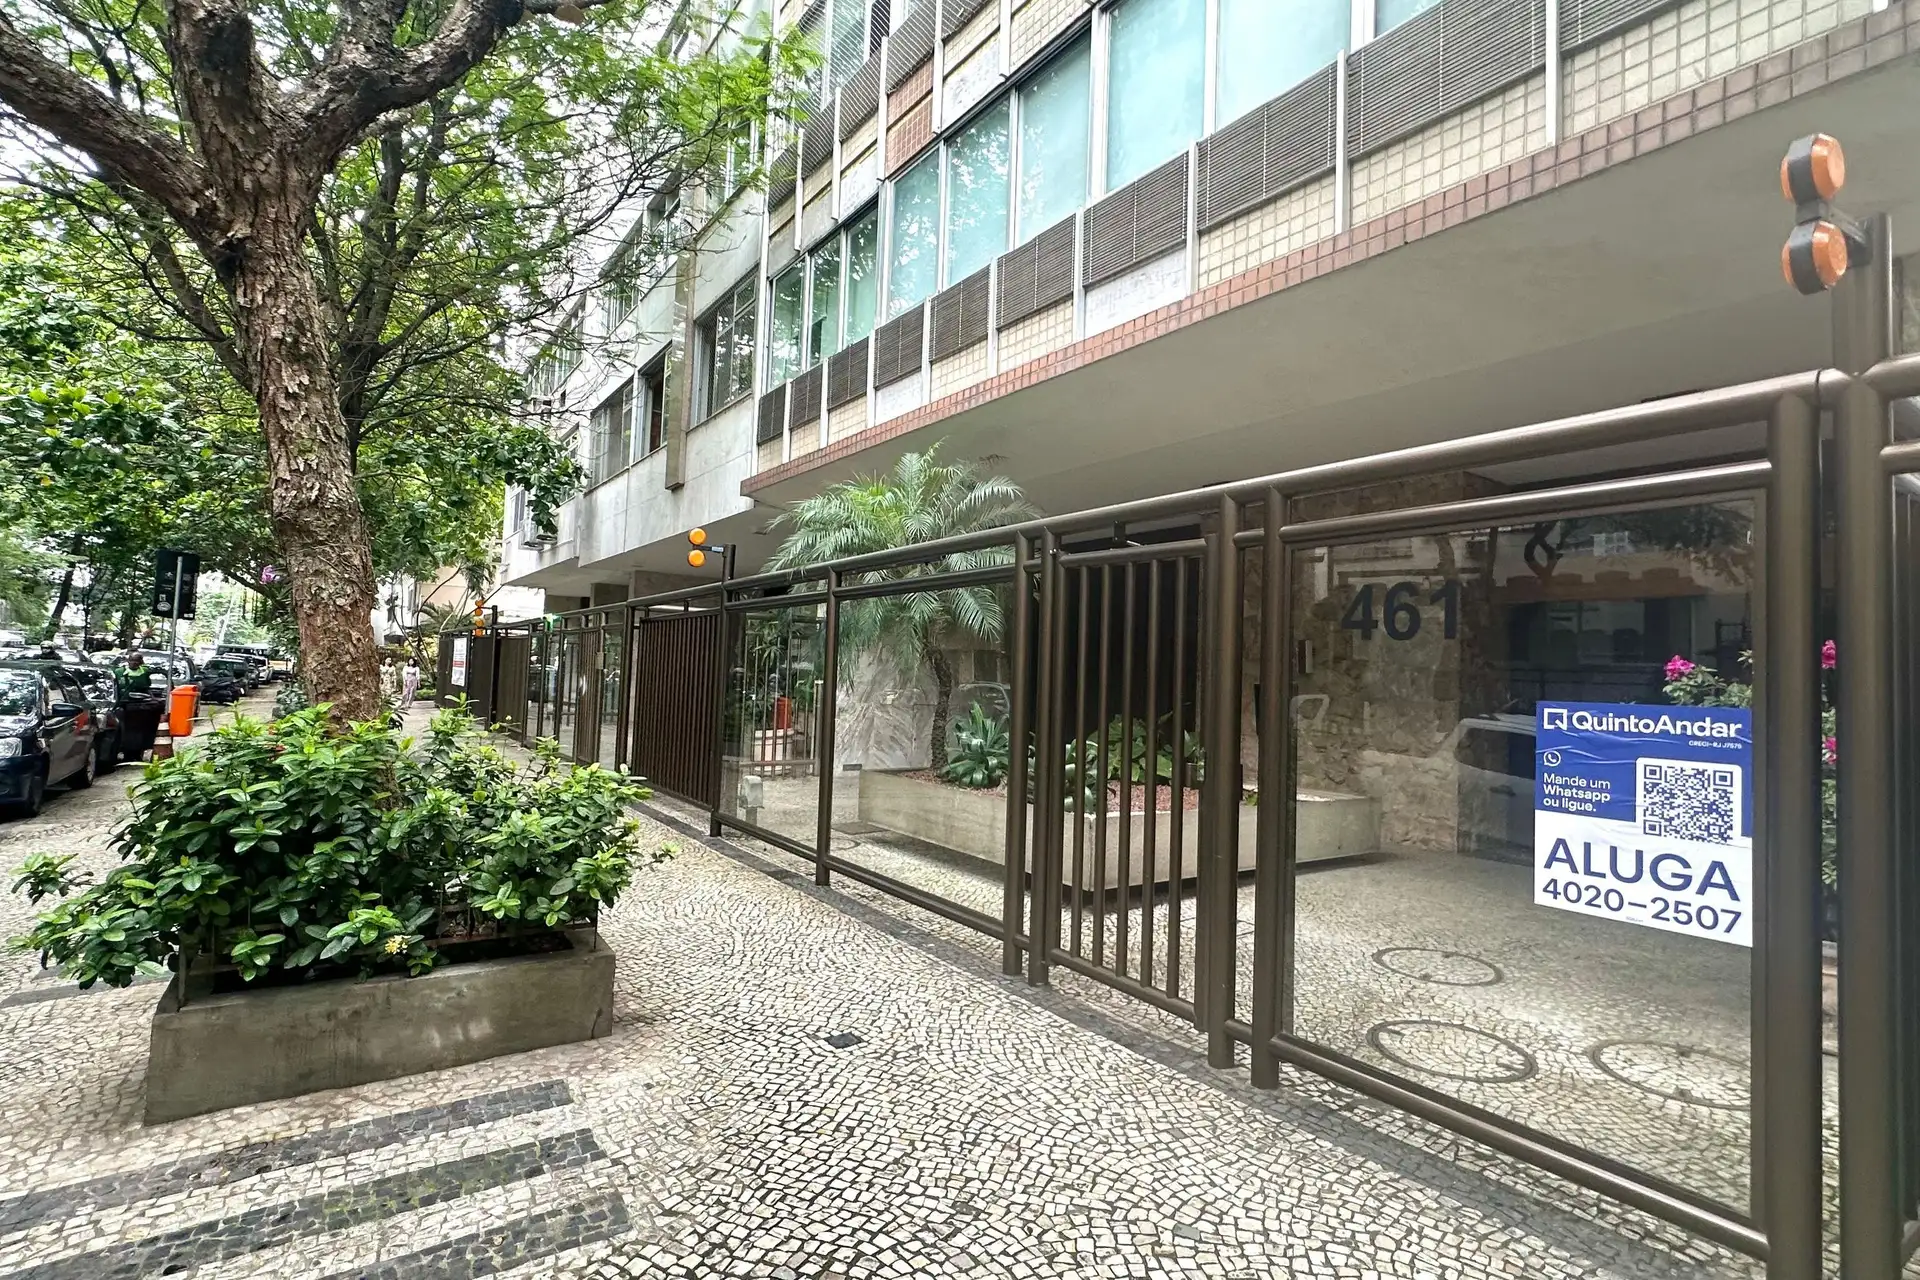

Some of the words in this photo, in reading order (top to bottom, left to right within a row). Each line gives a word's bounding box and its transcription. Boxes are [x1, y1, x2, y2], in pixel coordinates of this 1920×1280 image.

[1342, 580, 1458, 641] 461
[1572, 711, 1742, 738] QuintoAndar
[1543, 772, 1587, 787] Mande
[1589, 778, 1611, 789] um
[1543, 784, 1611, 802] Whatsapp
[1543, 798, 1559, 808] ou
[1561, 797, 1596, 812] ligue.
[1543, 837, 1740, 902] ALUGA
[1542, 878, 1741, 933] 4020-2507
